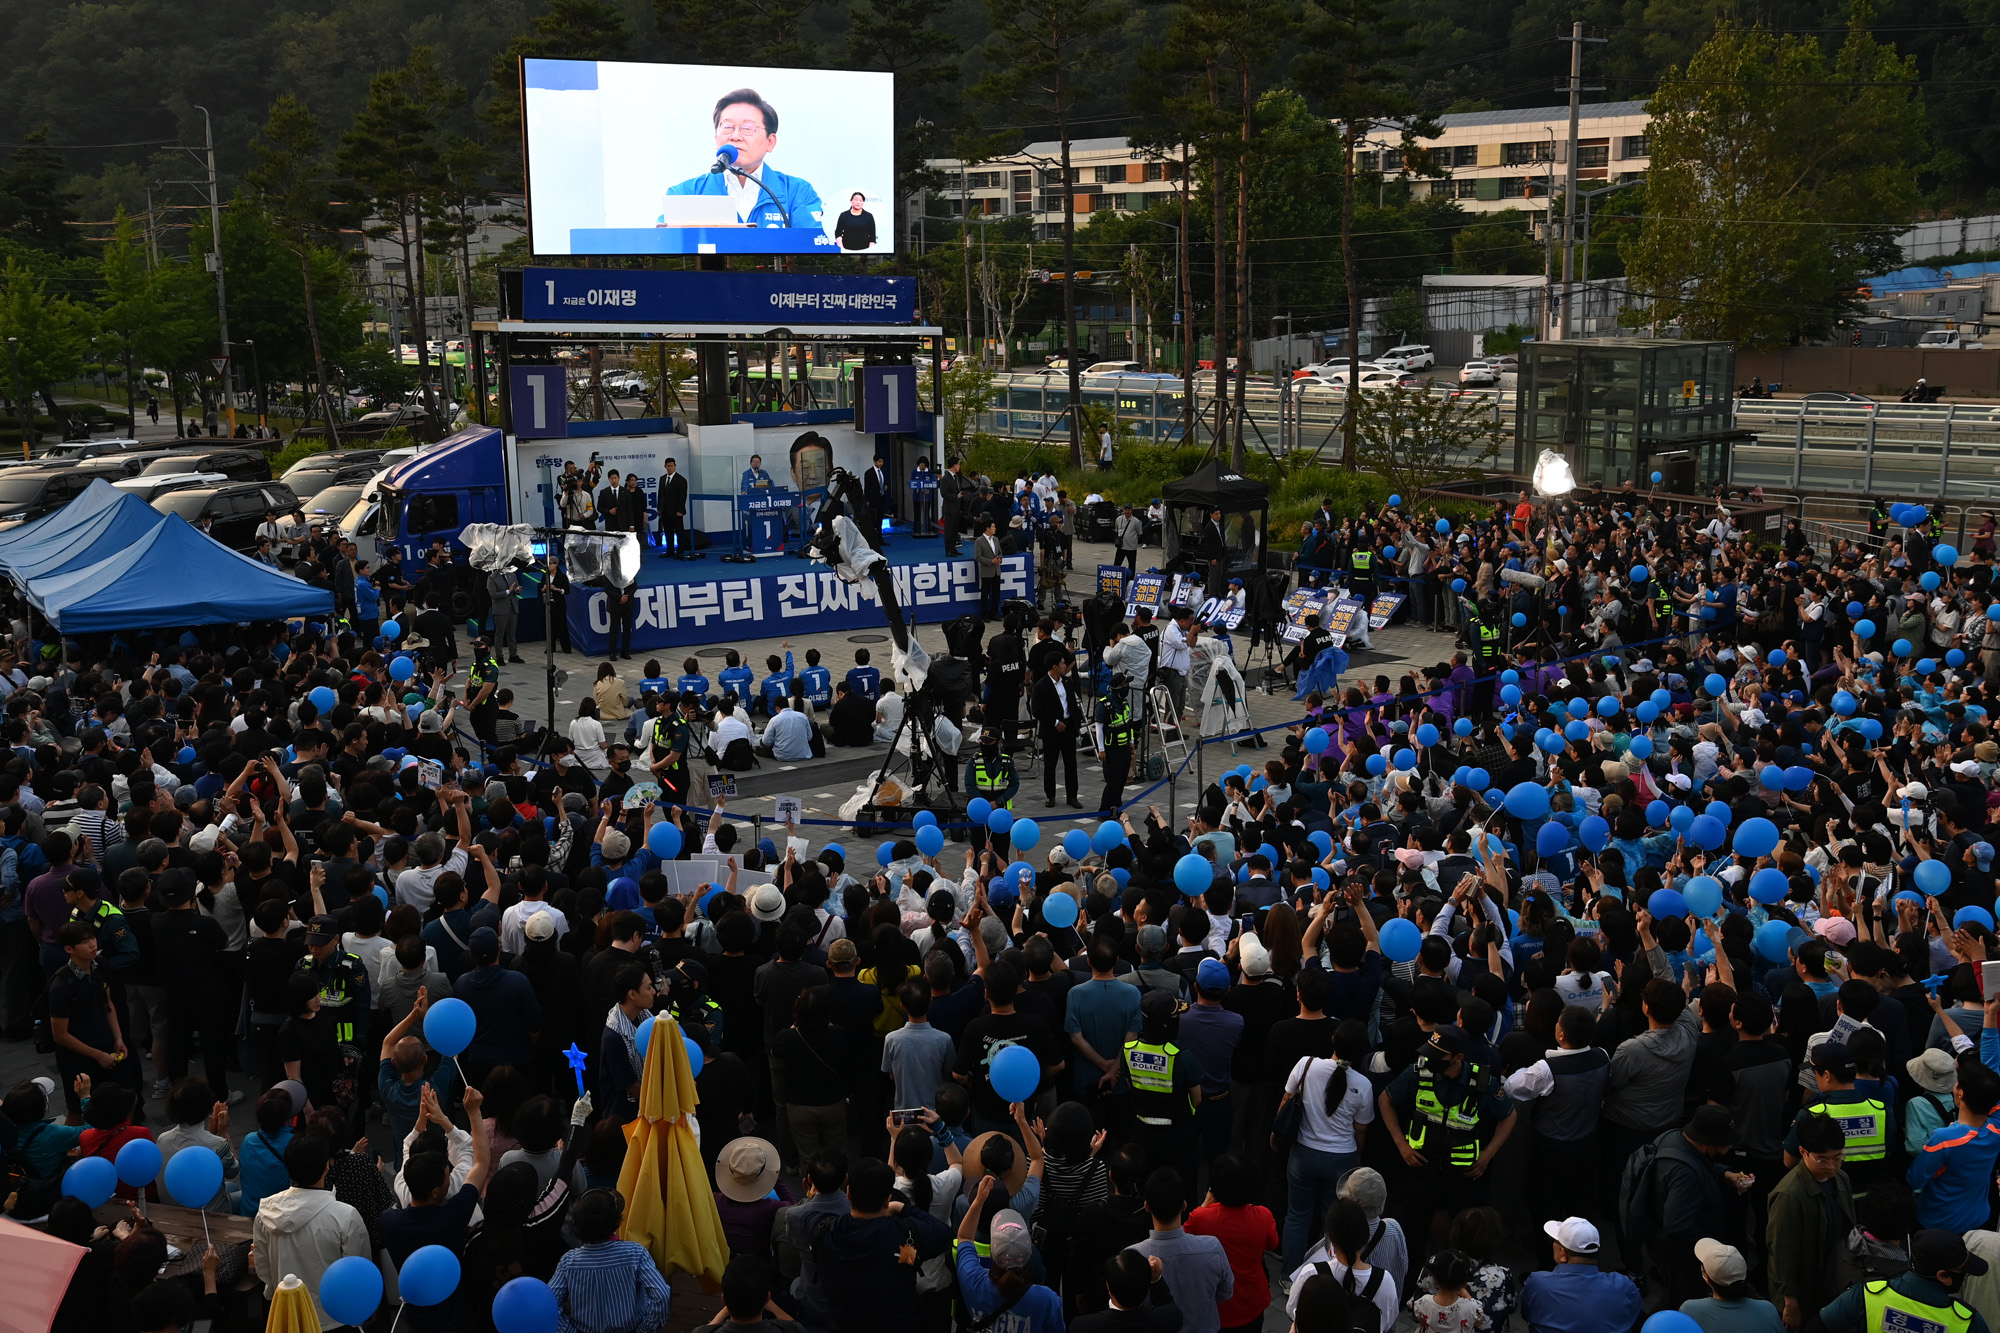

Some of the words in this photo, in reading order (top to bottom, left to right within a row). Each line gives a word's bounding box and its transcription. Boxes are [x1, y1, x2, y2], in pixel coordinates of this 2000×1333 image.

[545, 280, 555, 305] 1
[563, 297, 586, 305] 지금은
[587, 289, 637, 306] 이재명
[770, 293, 820, 309] 이제부터
[822, 294, 847, 309] 진짜
[848, 294, 898, 309] 대한민국
[526, 375, 546, 429] 1
[882, 374, 898, 424] 1
[536, 458, 563, 468] 민주당
[637, 477, 657, 489] 금은
[748, 501, 767, 509] 지금은
[767, 496, 772, 508] 1
[773, 499, 792, 507] 이재명
[763, 521, 771, 539] 1
[404, 545, 412, 561] 1
[1100, 570, 1123, 579] 사전투표
[1137, 577, 1162, 586] 사전투표
[811, 673, 820, 691] 1
[861, 678, 868, 692] 1
[776, 682, 787, 699] 1
[711, 784, 736, 796] 이재명
[1565, 852, 1575, 873] 1
[1132, 1062, 1164, 1072] POLICE
[1844, 1128, 1873, 1137] OLICE
